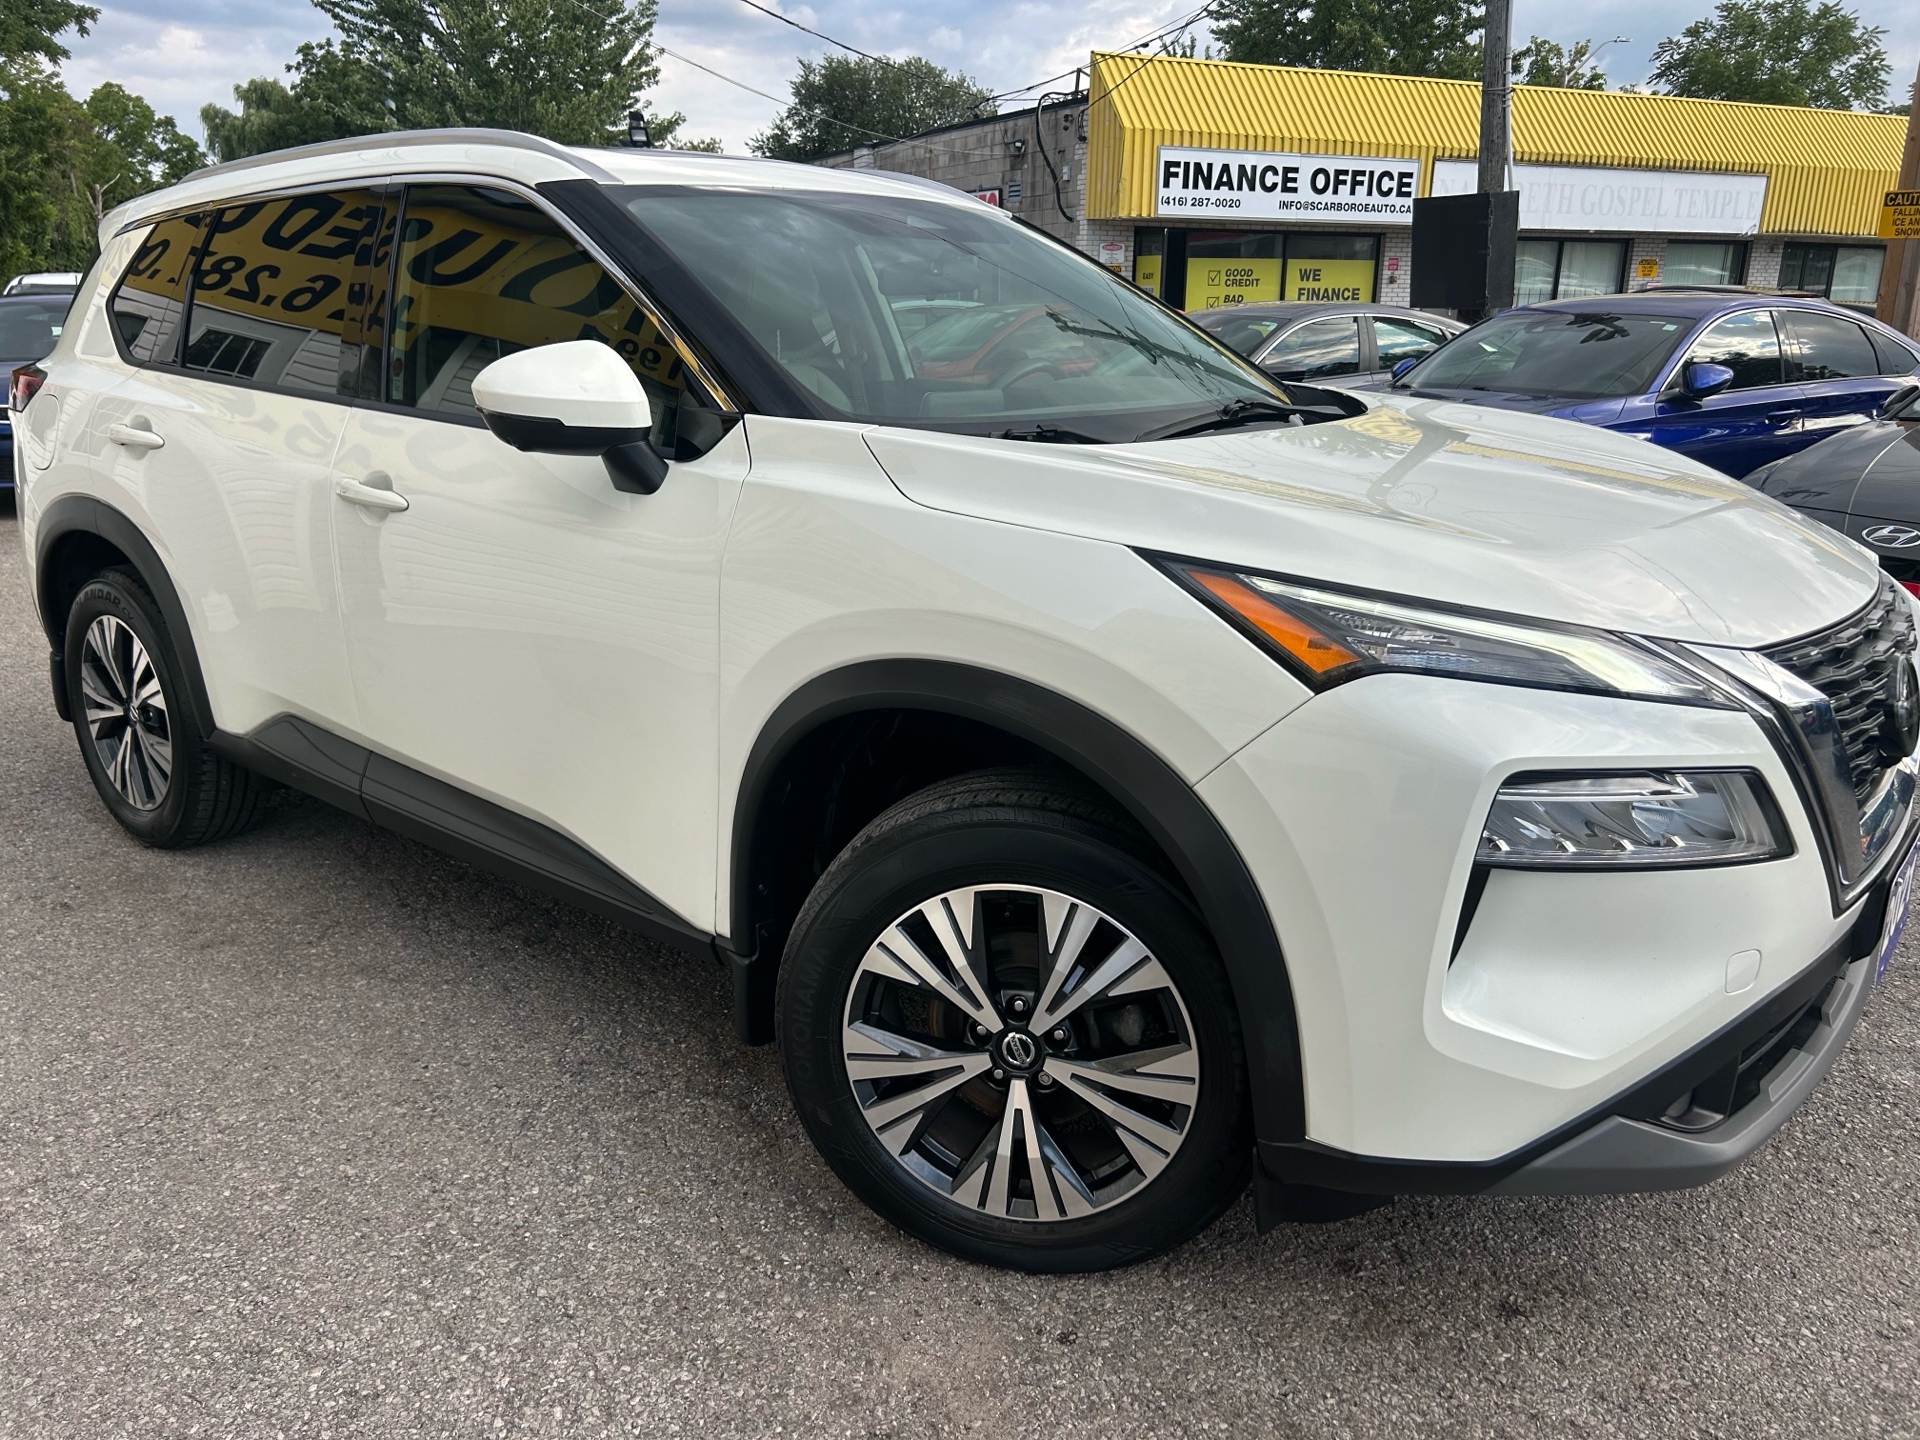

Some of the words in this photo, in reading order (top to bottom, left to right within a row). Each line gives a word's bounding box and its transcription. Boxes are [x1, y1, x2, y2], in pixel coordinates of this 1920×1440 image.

[1162, 160, 1300, 194] FINANCE
[1309, 167, 1414, 198] OFFICE
[1160, 195, 1188, 207] (416)
[1190, 197, 1241, 209] 287-0020
[1580, 184, 1670, 217] GOSPEL
[1674, 188, 1761, 220] TEMPLE
[1887, 193, 1920, 206] CAUT
[1278, 200, 1412, 215] INFO@SCARBOROEAUTO.CA
[1893, 208, 1920, 217] FALLIN
[1892, 217, 1906, 226] ICE
[1907, 217, 1920, 226] AN
[1894, 227, 1920, 236] SNOW
[1225, 268, 1254, 278] GOOD
[1299, 268, 1322, 282] WE
[1224, 278, 1260, 288] CREDIT
[1223, 294, 1244, 304] BAD
[1297, 287, 1360, 301] FINANCE
[1010, 1036, 1026, 1065] NISSAN
